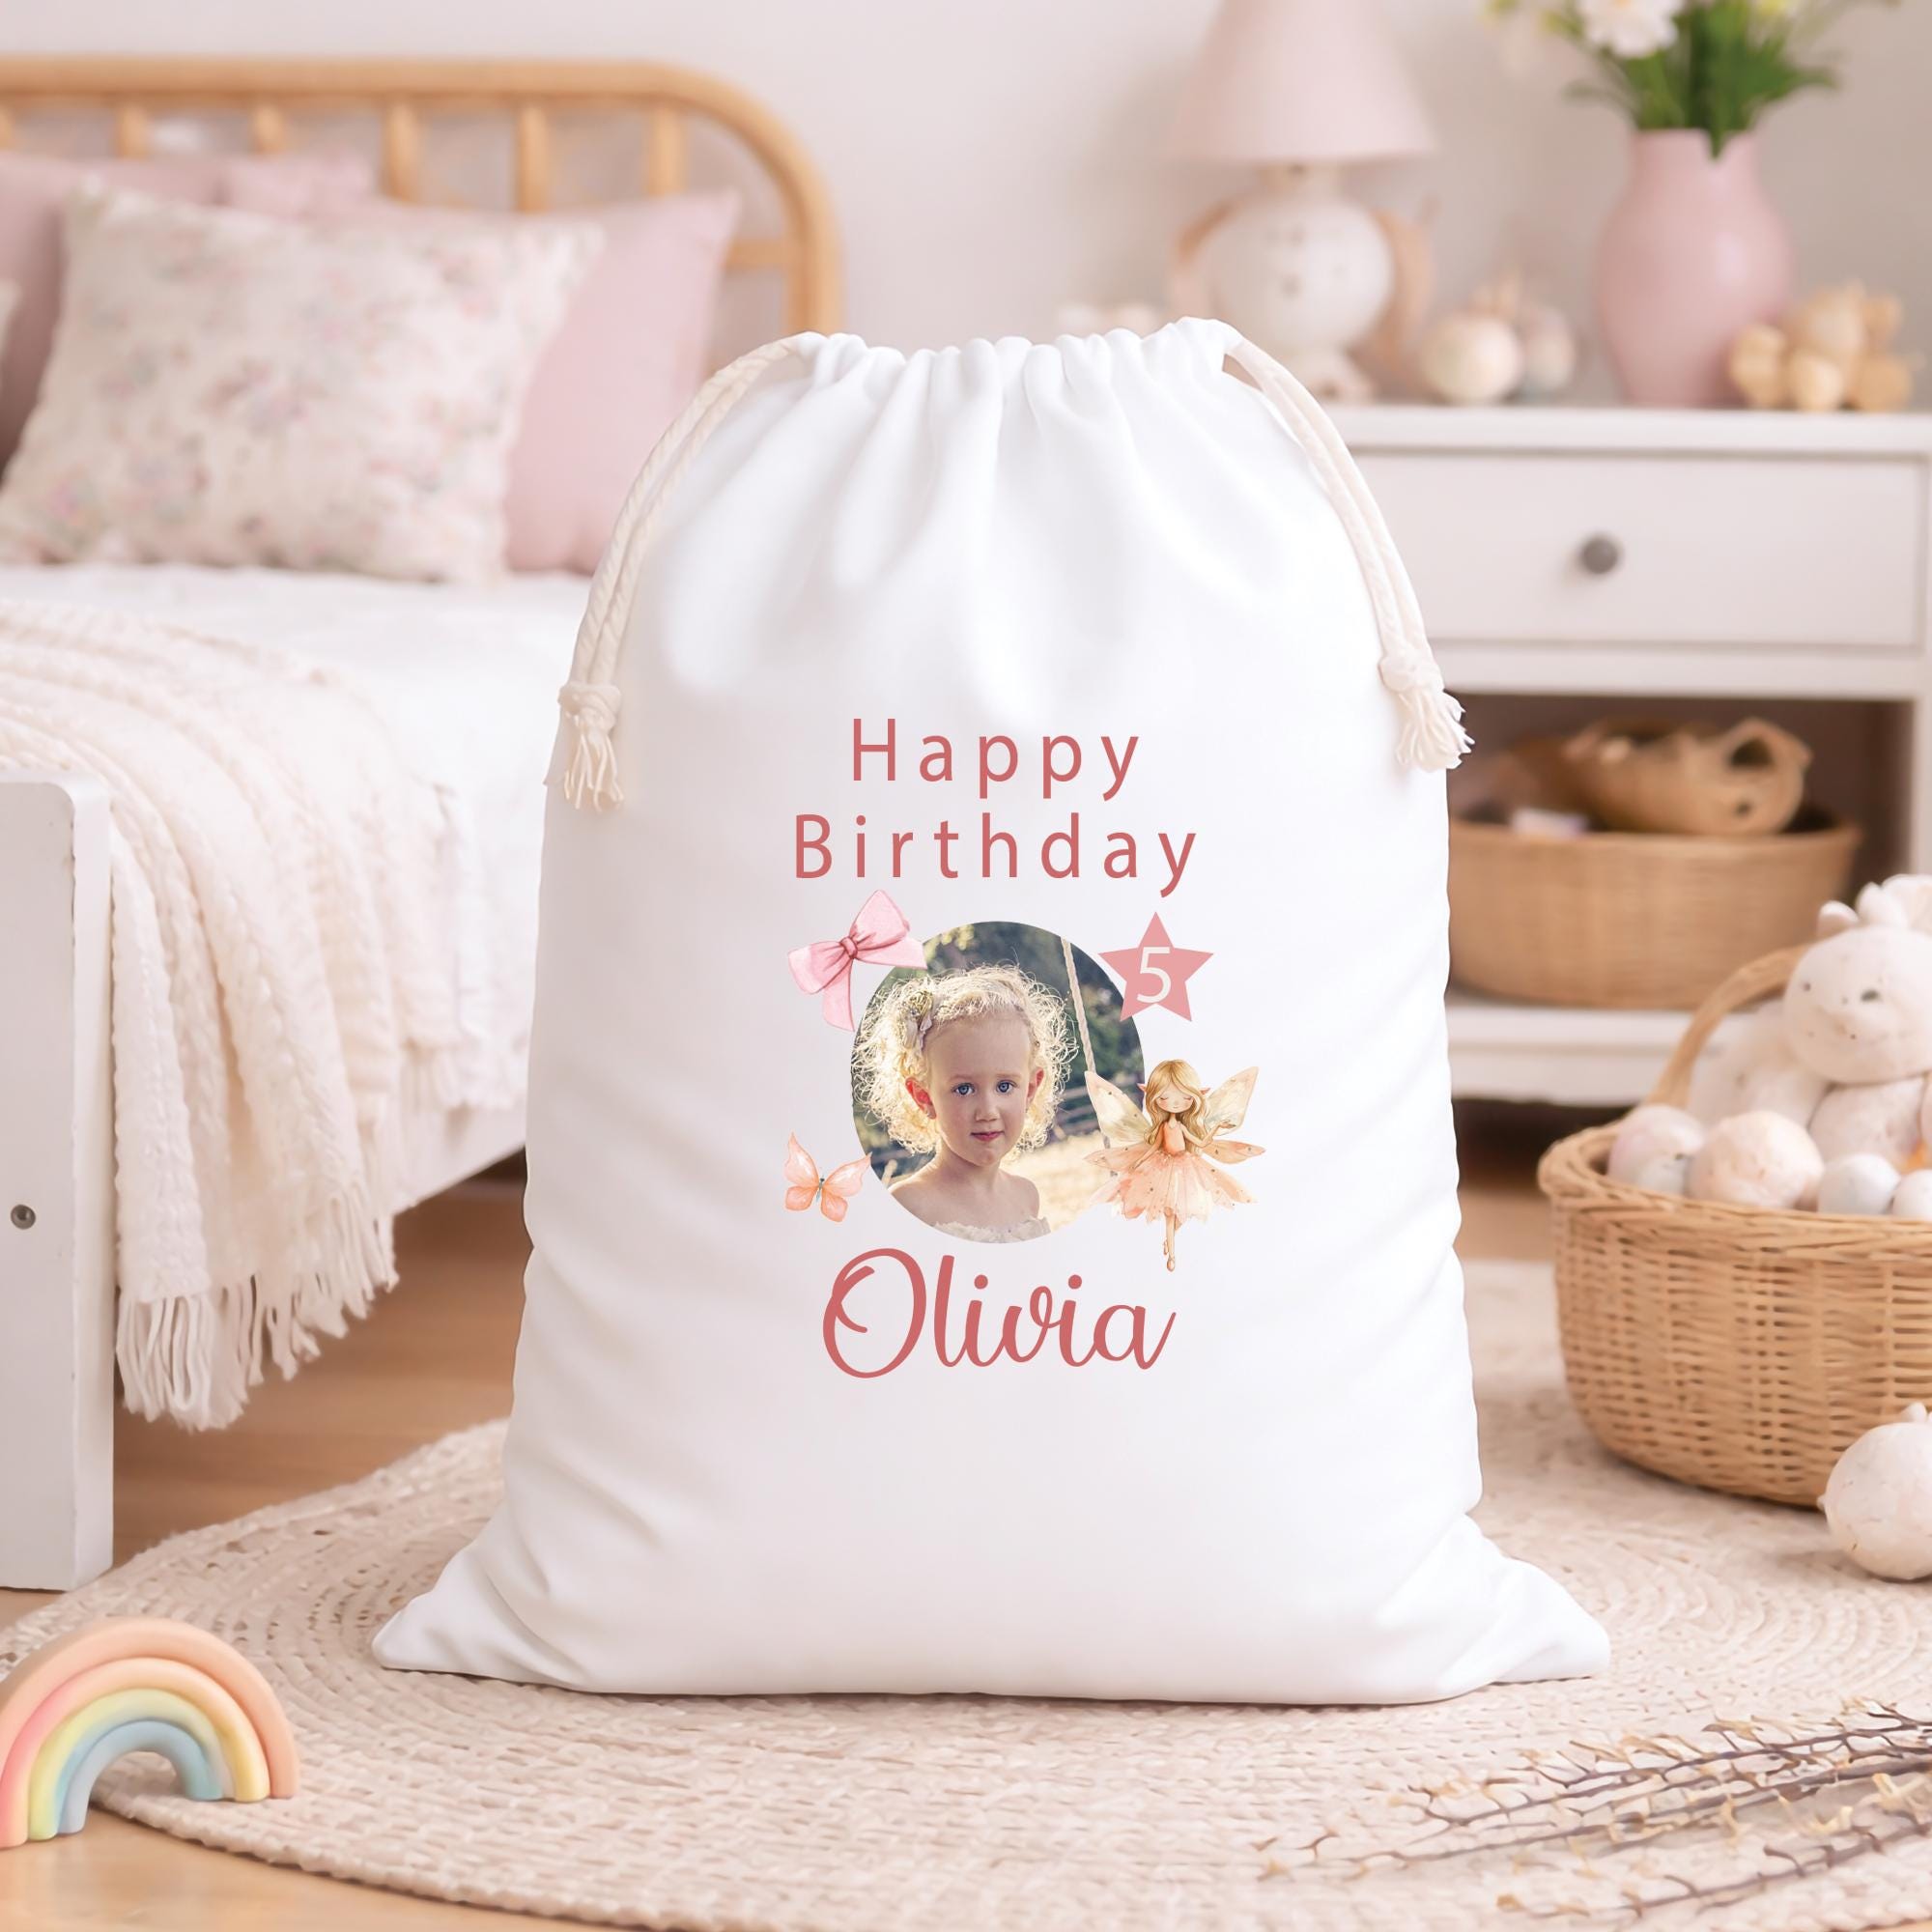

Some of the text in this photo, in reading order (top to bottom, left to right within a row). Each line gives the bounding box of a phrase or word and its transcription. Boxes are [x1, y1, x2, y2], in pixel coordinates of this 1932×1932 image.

[853, 718, 1139, 801] Happy
[795, 812, 1196, 897] Birthday
[1136, 946, 1172, 1004] 5
[822, 1248, 1177, 1379] Olivia
